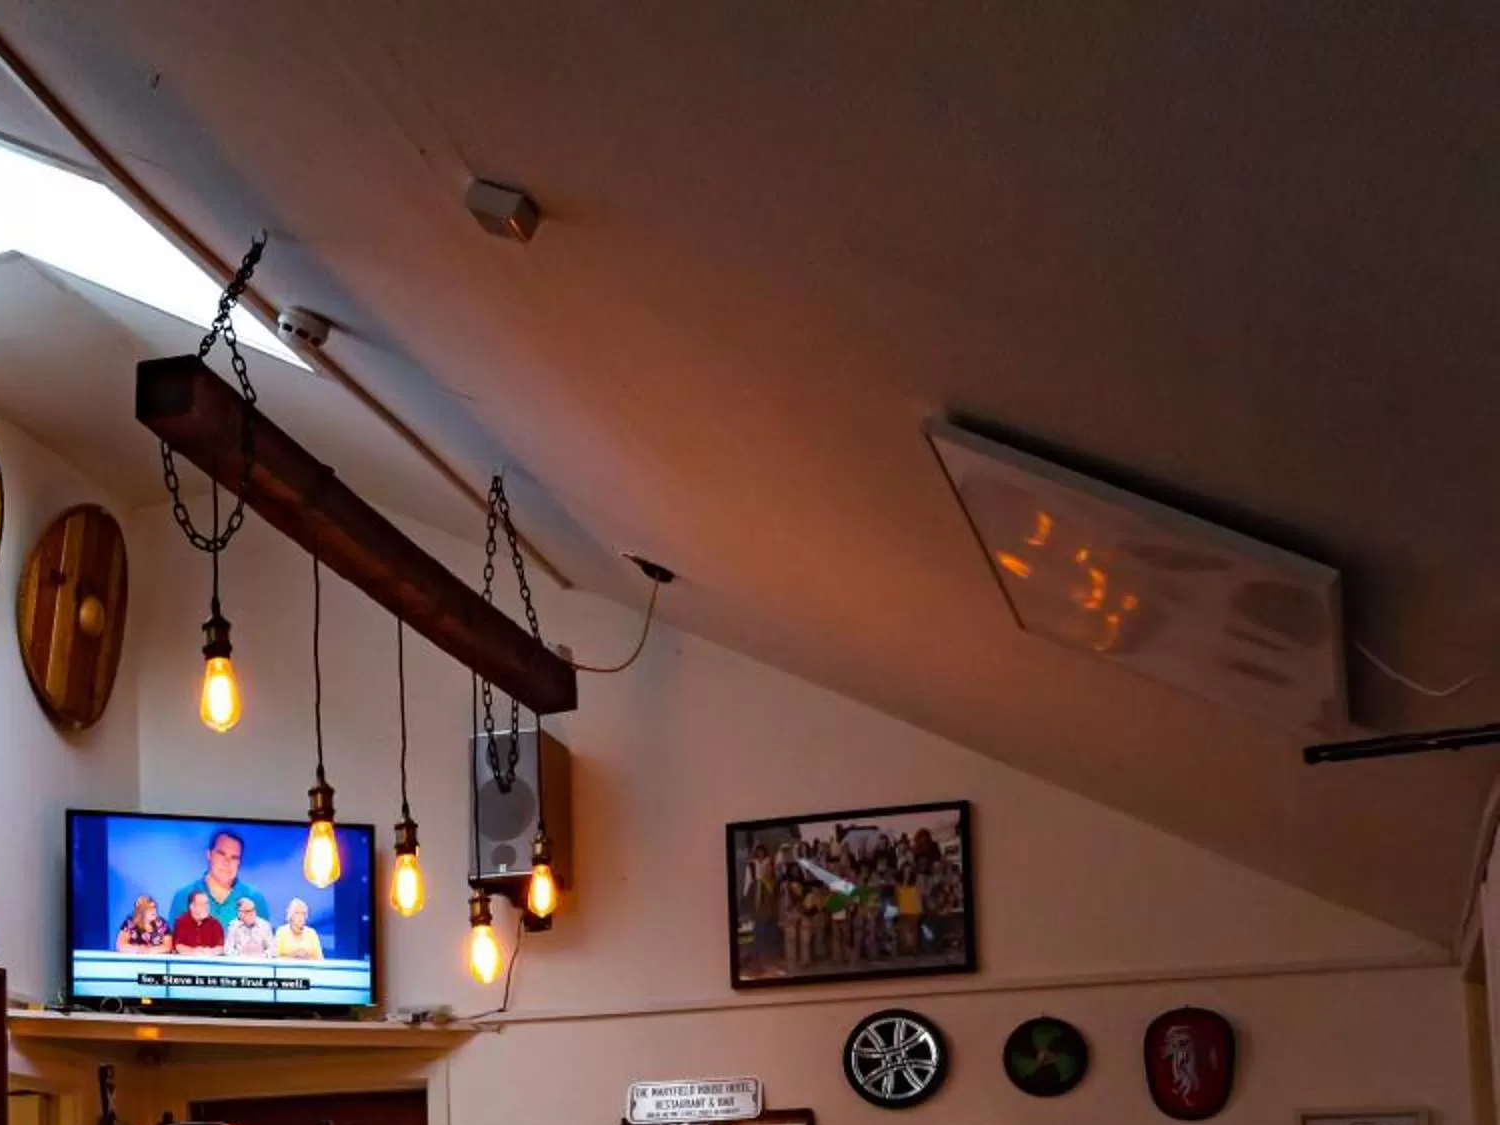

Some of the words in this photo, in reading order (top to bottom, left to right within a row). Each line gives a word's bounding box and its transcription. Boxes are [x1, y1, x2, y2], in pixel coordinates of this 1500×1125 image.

[163, 975, 192, 985] Steve
[220, 976, 237, 986] the
[241, 977, 263, 987] final
[267, 979, 279, 988] as
[282, 979, 307, 989] well.
